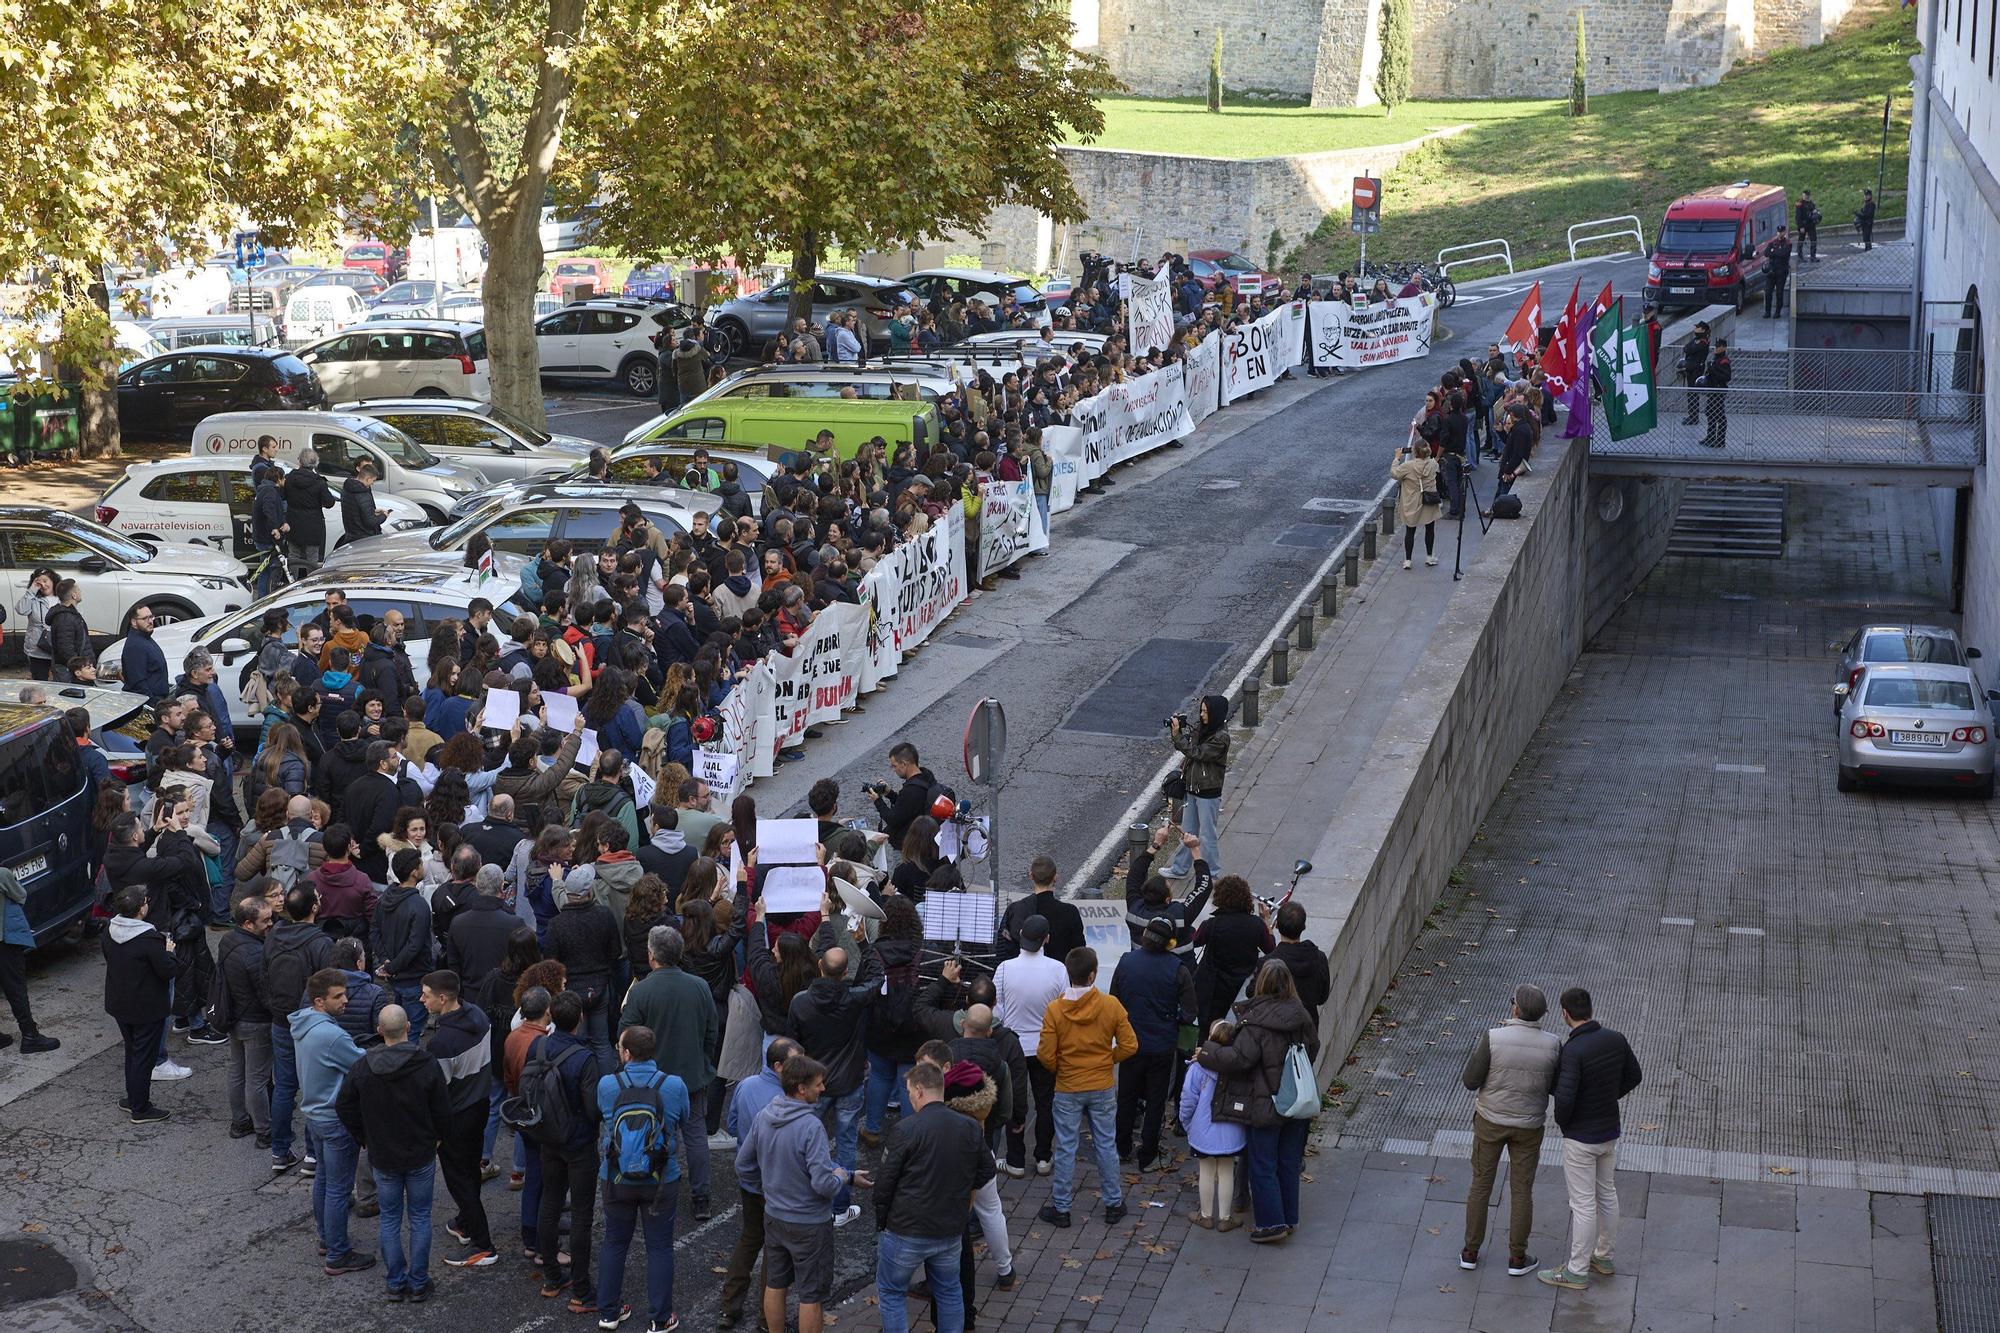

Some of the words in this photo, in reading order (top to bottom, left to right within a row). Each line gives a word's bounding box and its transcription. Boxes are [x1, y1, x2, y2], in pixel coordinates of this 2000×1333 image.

[1382, 334, 1409, 347] NAVARRA
[1246, 354, 1267, 380] EN
[1900, 733, 1922, 742] 3889
[1923, 735, 1941, 743] GJN
